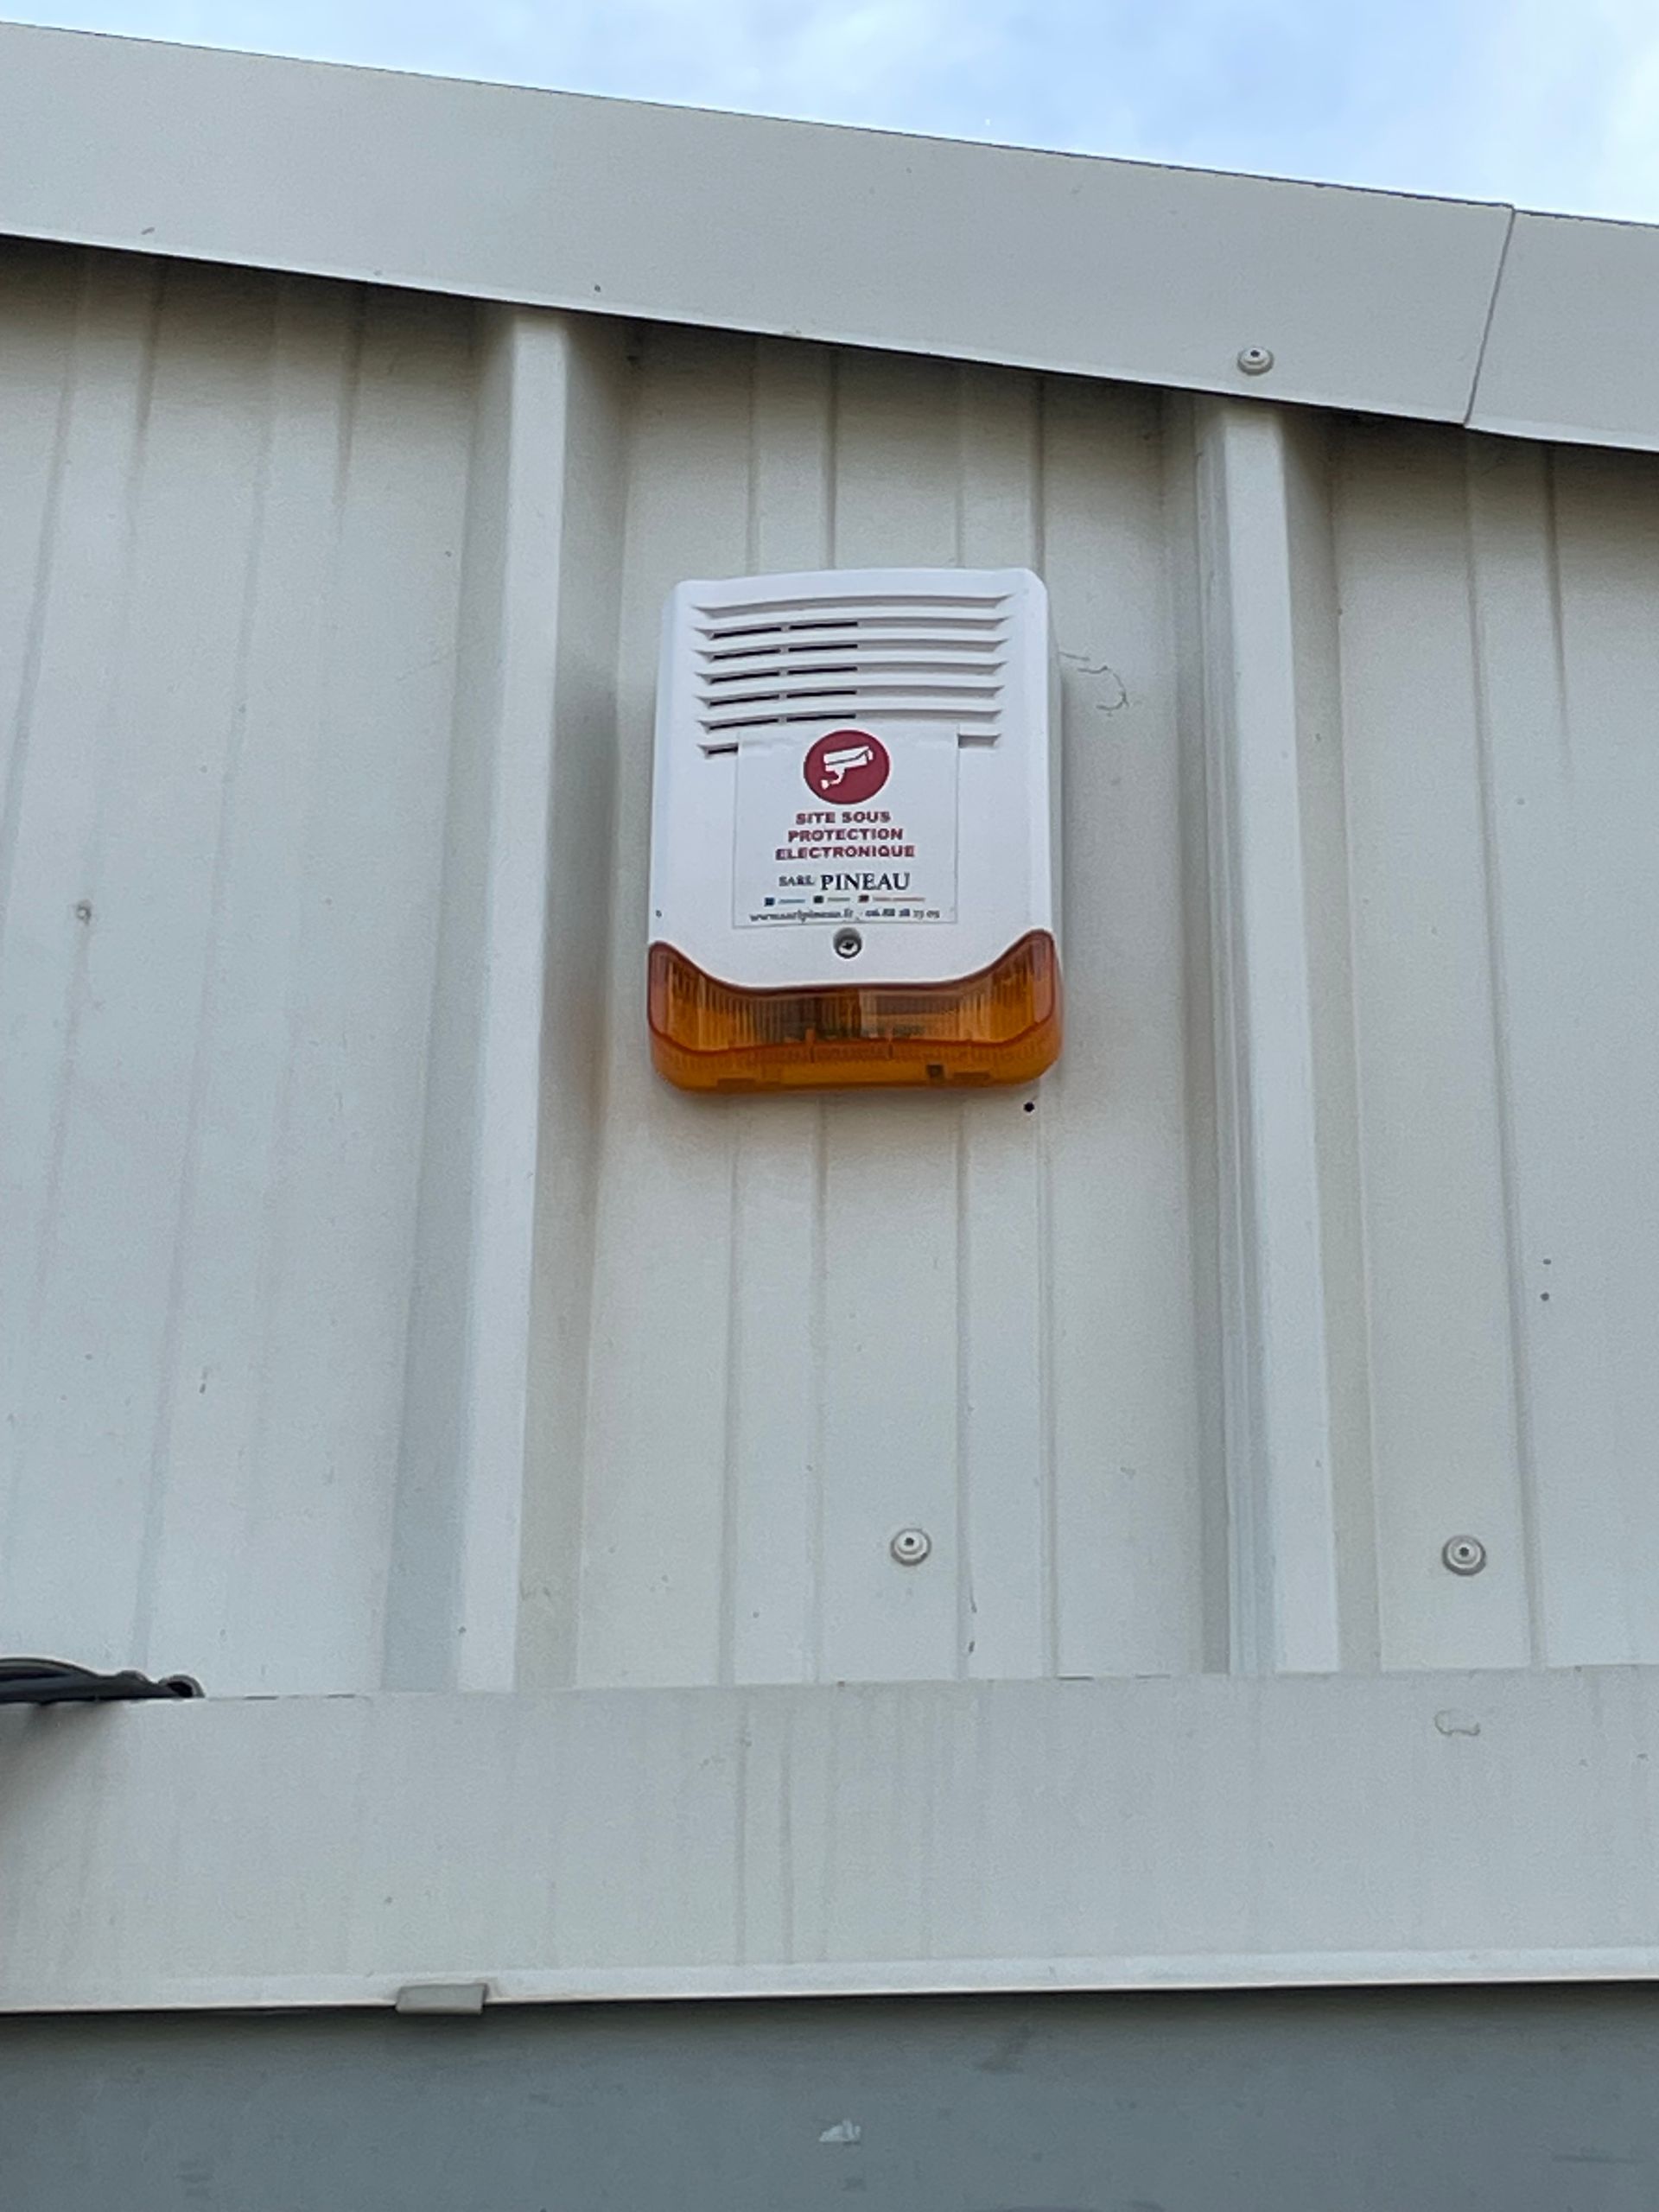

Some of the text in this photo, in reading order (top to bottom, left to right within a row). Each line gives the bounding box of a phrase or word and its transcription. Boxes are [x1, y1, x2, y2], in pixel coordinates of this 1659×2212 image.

[796, 810, 891, 825] SITE SOUS
[788, 828, 903, 842] PROTECTION
[775, 844, 915, 861] ELECTRONIQUE
[821, 872, 910, 891] PINEAU
